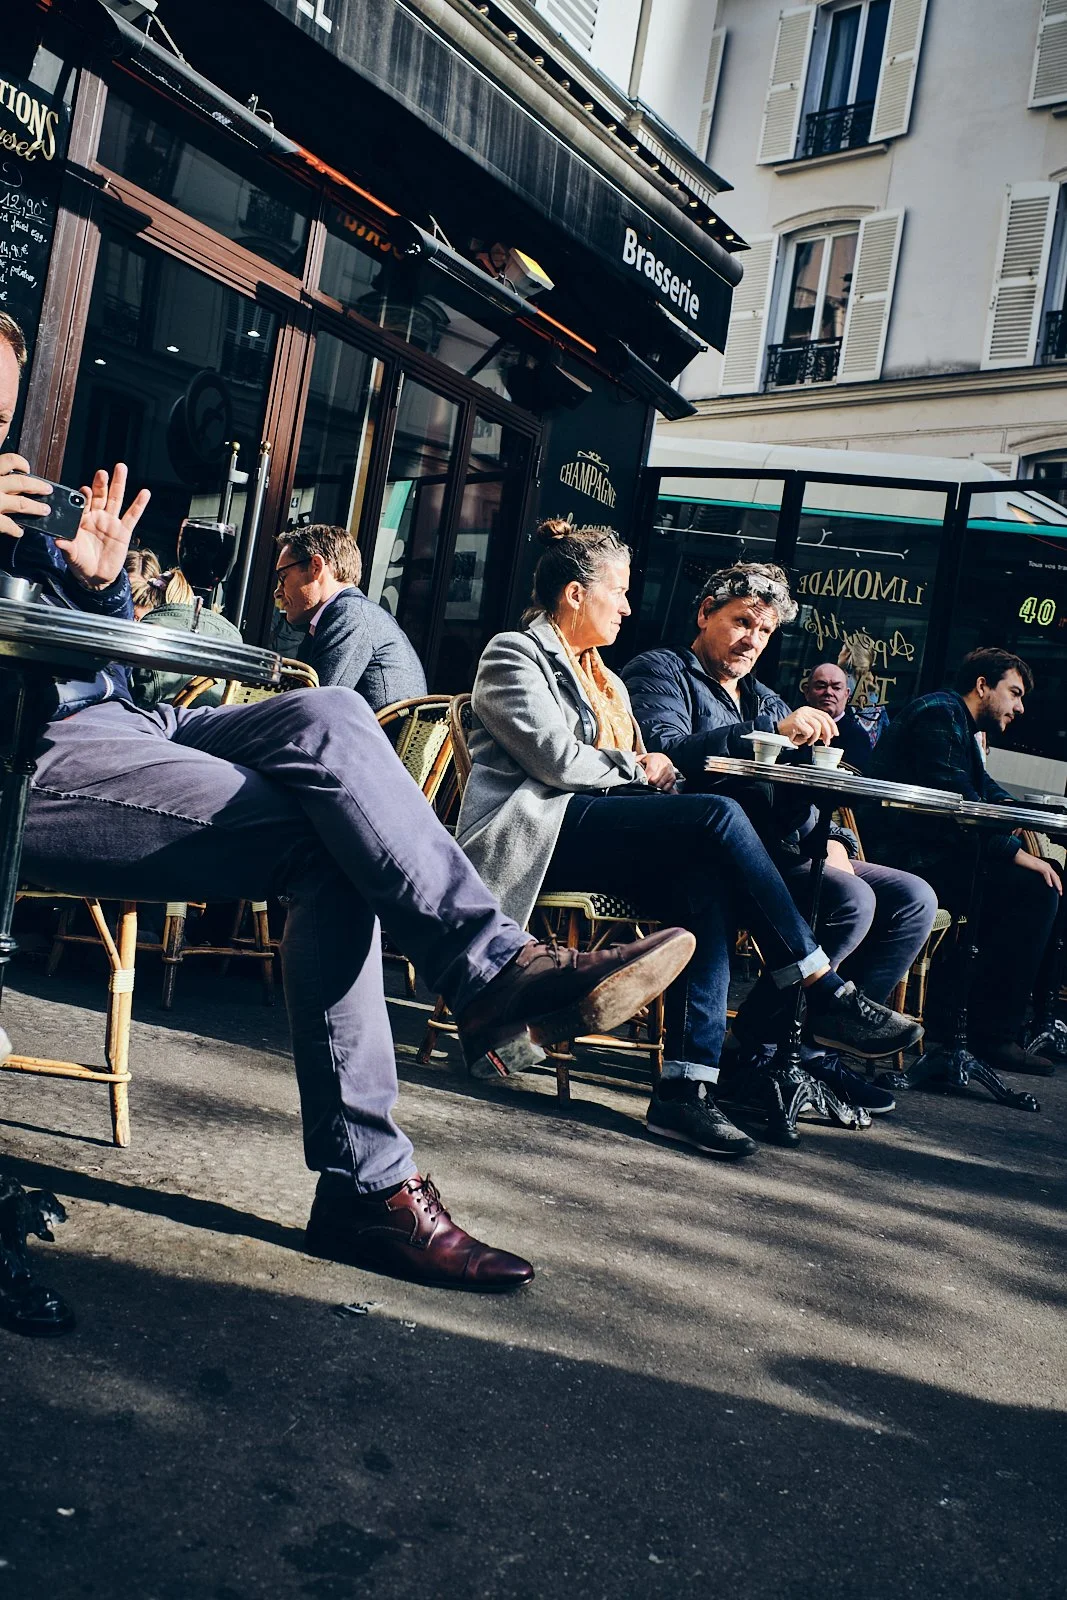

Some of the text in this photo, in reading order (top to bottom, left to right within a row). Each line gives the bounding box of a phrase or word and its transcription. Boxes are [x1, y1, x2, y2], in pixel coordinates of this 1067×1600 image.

[623, 227, 700, 320] Brasserie
[560, 462, 616, 509] CHAMPAGNE
[1019, 596, 1056, 626] 40
